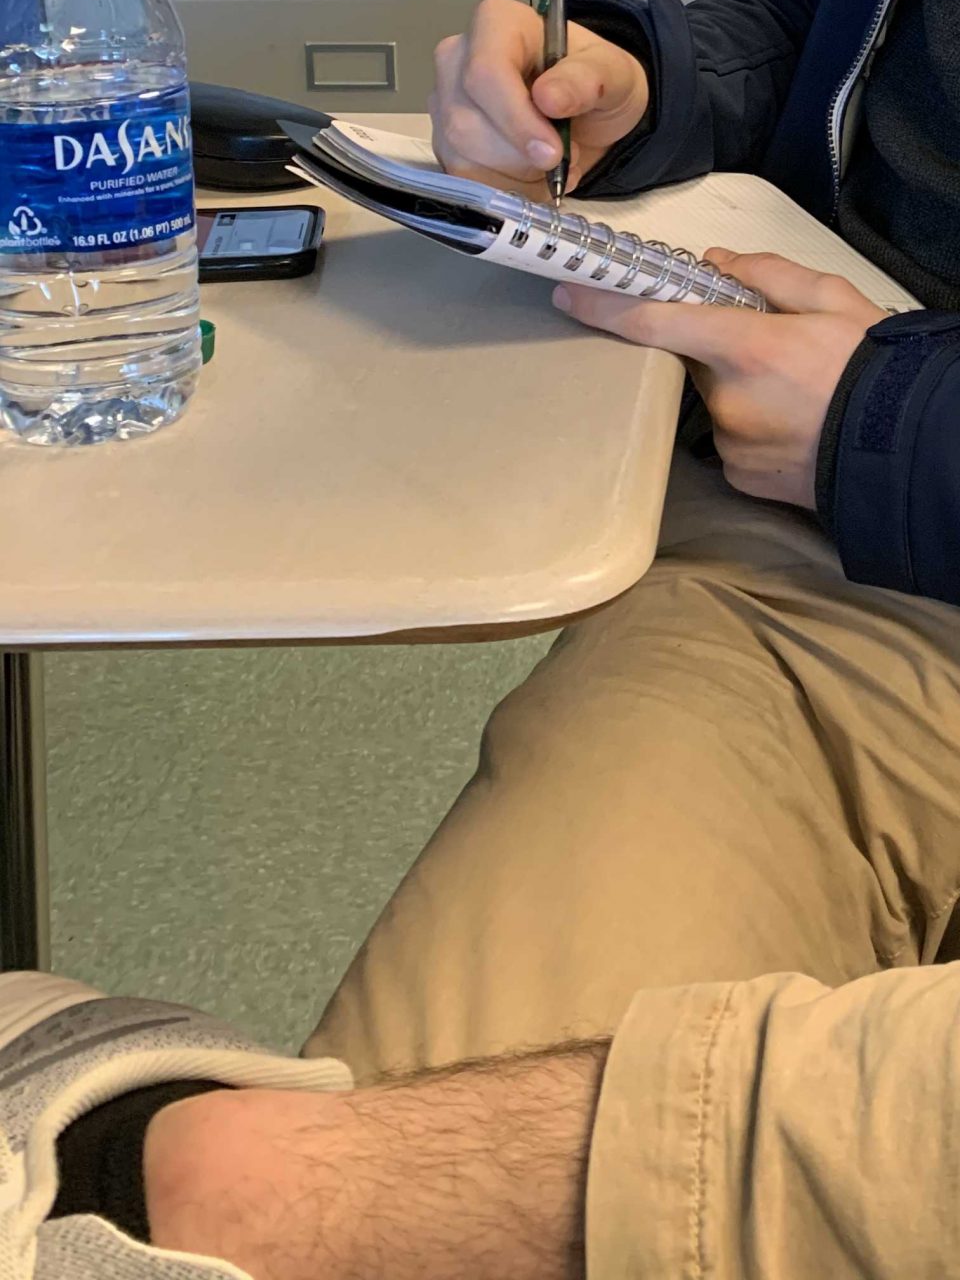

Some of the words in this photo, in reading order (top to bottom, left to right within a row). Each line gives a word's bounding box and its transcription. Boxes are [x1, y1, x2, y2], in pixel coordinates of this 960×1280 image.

[89, 175, 145, 191] PURIFIED
[146, 166, 179, 182] WATER
[72, 235, 96, 247] 16.9
[97, 233, 111, 245] FL
[112, 230, 127, 243] OZ
[129, 225, 154, 242] (1.06
[155, 220, 170, 236] PT)
[170, 217, 184, 231] 500
